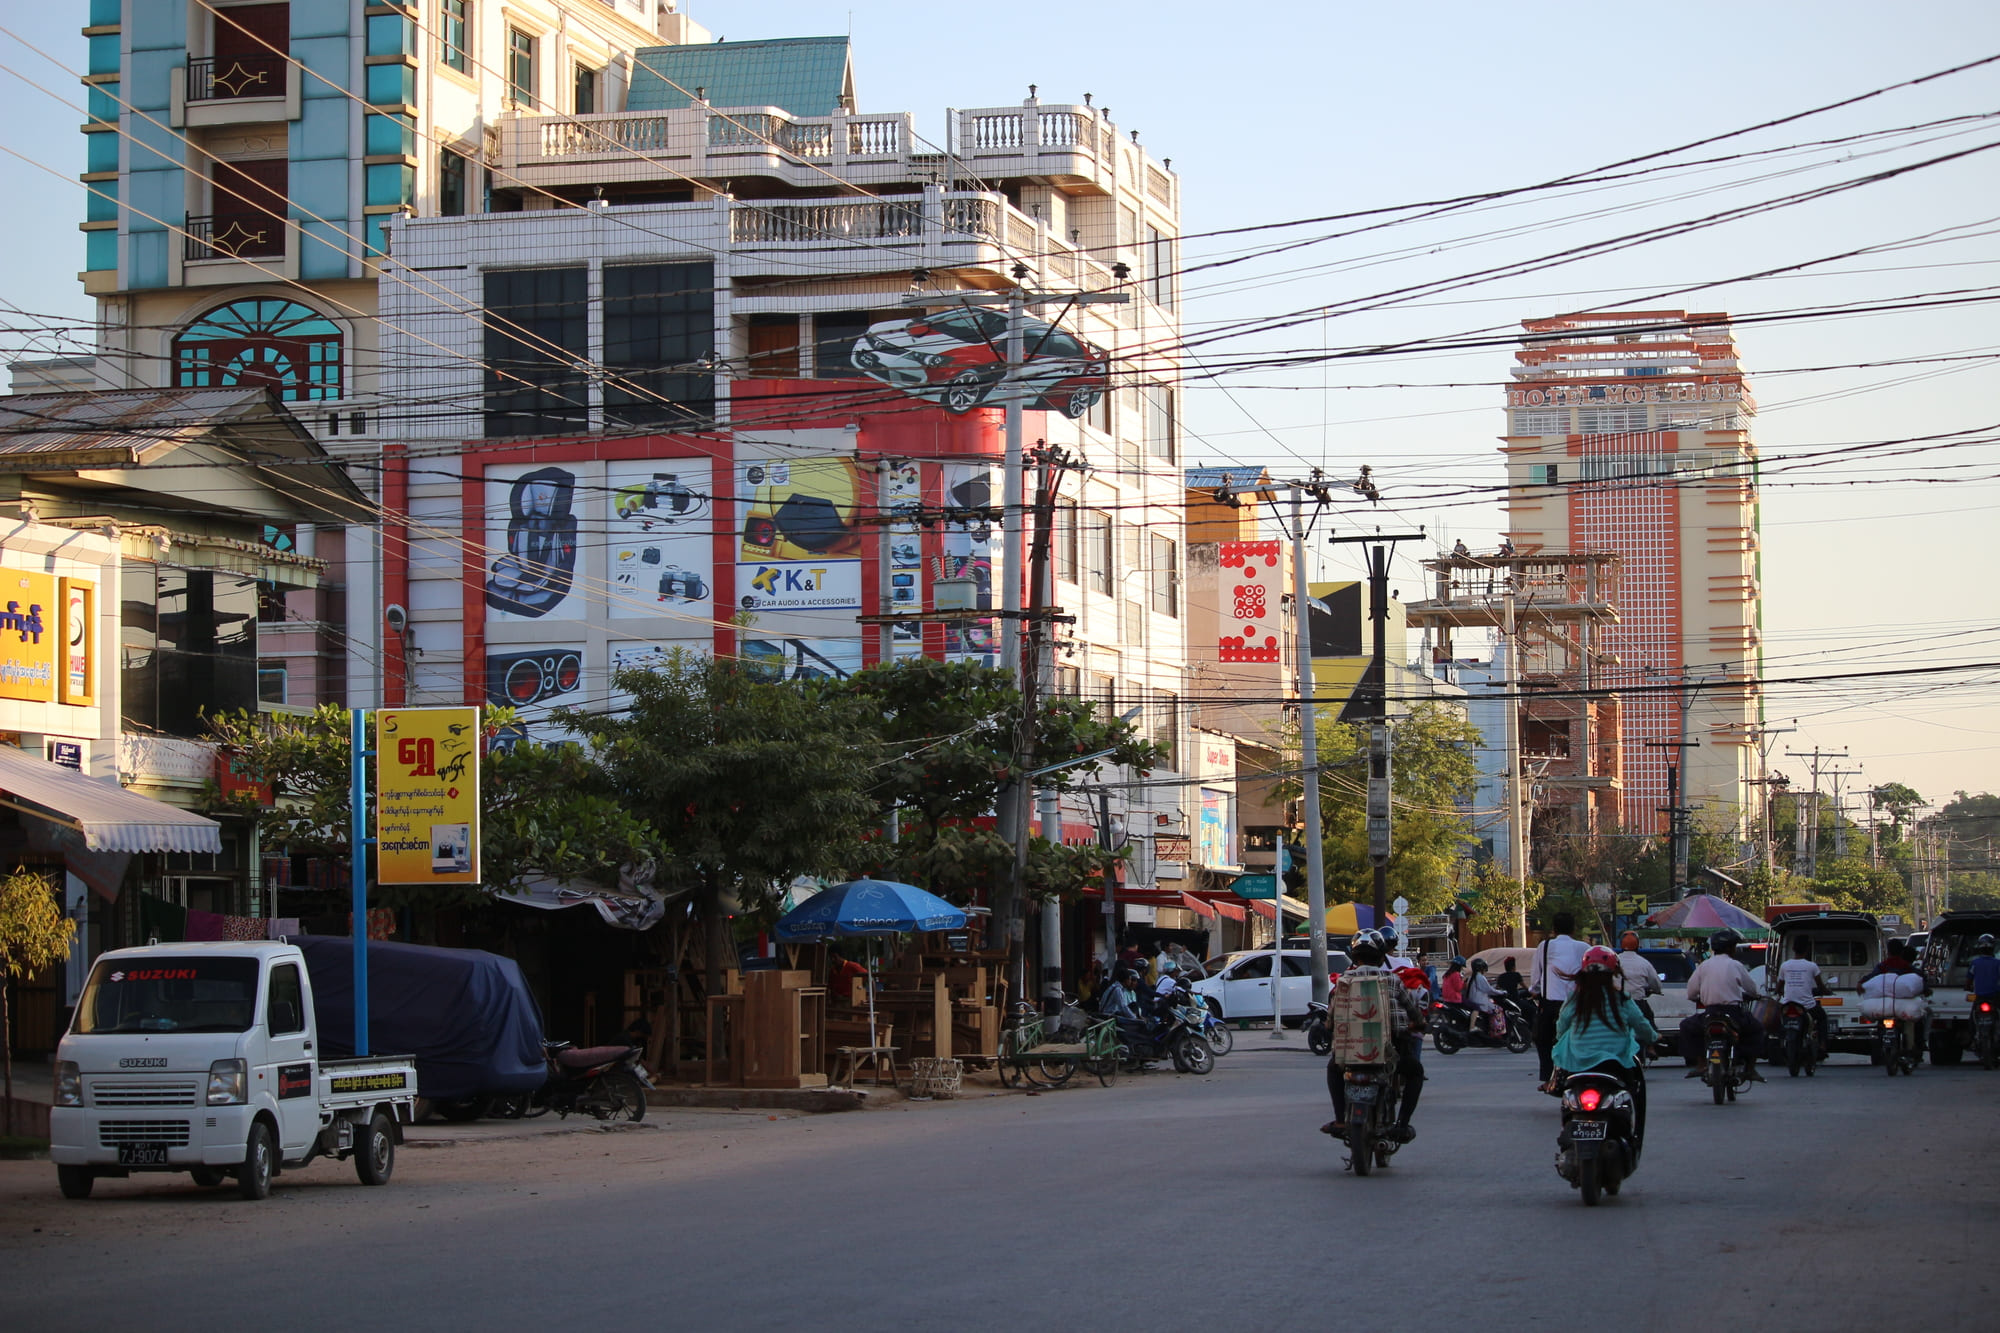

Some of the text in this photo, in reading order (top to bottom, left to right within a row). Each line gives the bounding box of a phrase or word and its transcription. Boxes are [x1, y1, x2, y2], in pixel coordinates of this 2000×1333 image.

[1507, 382, 1740, 408] HOTEL MOE THEE
[785, 568, 827, 592] K&T
[761, 599, 777, 607] CAR
[777, 599, 800, 607] AUDIO
[807, 597, 857, 606] ACCESSORIES
[852, 916, 900, 928] telenor
[127, 969, 197, 981] SUZUKI
[119, 1057, 168, 1068] SUZUKI
